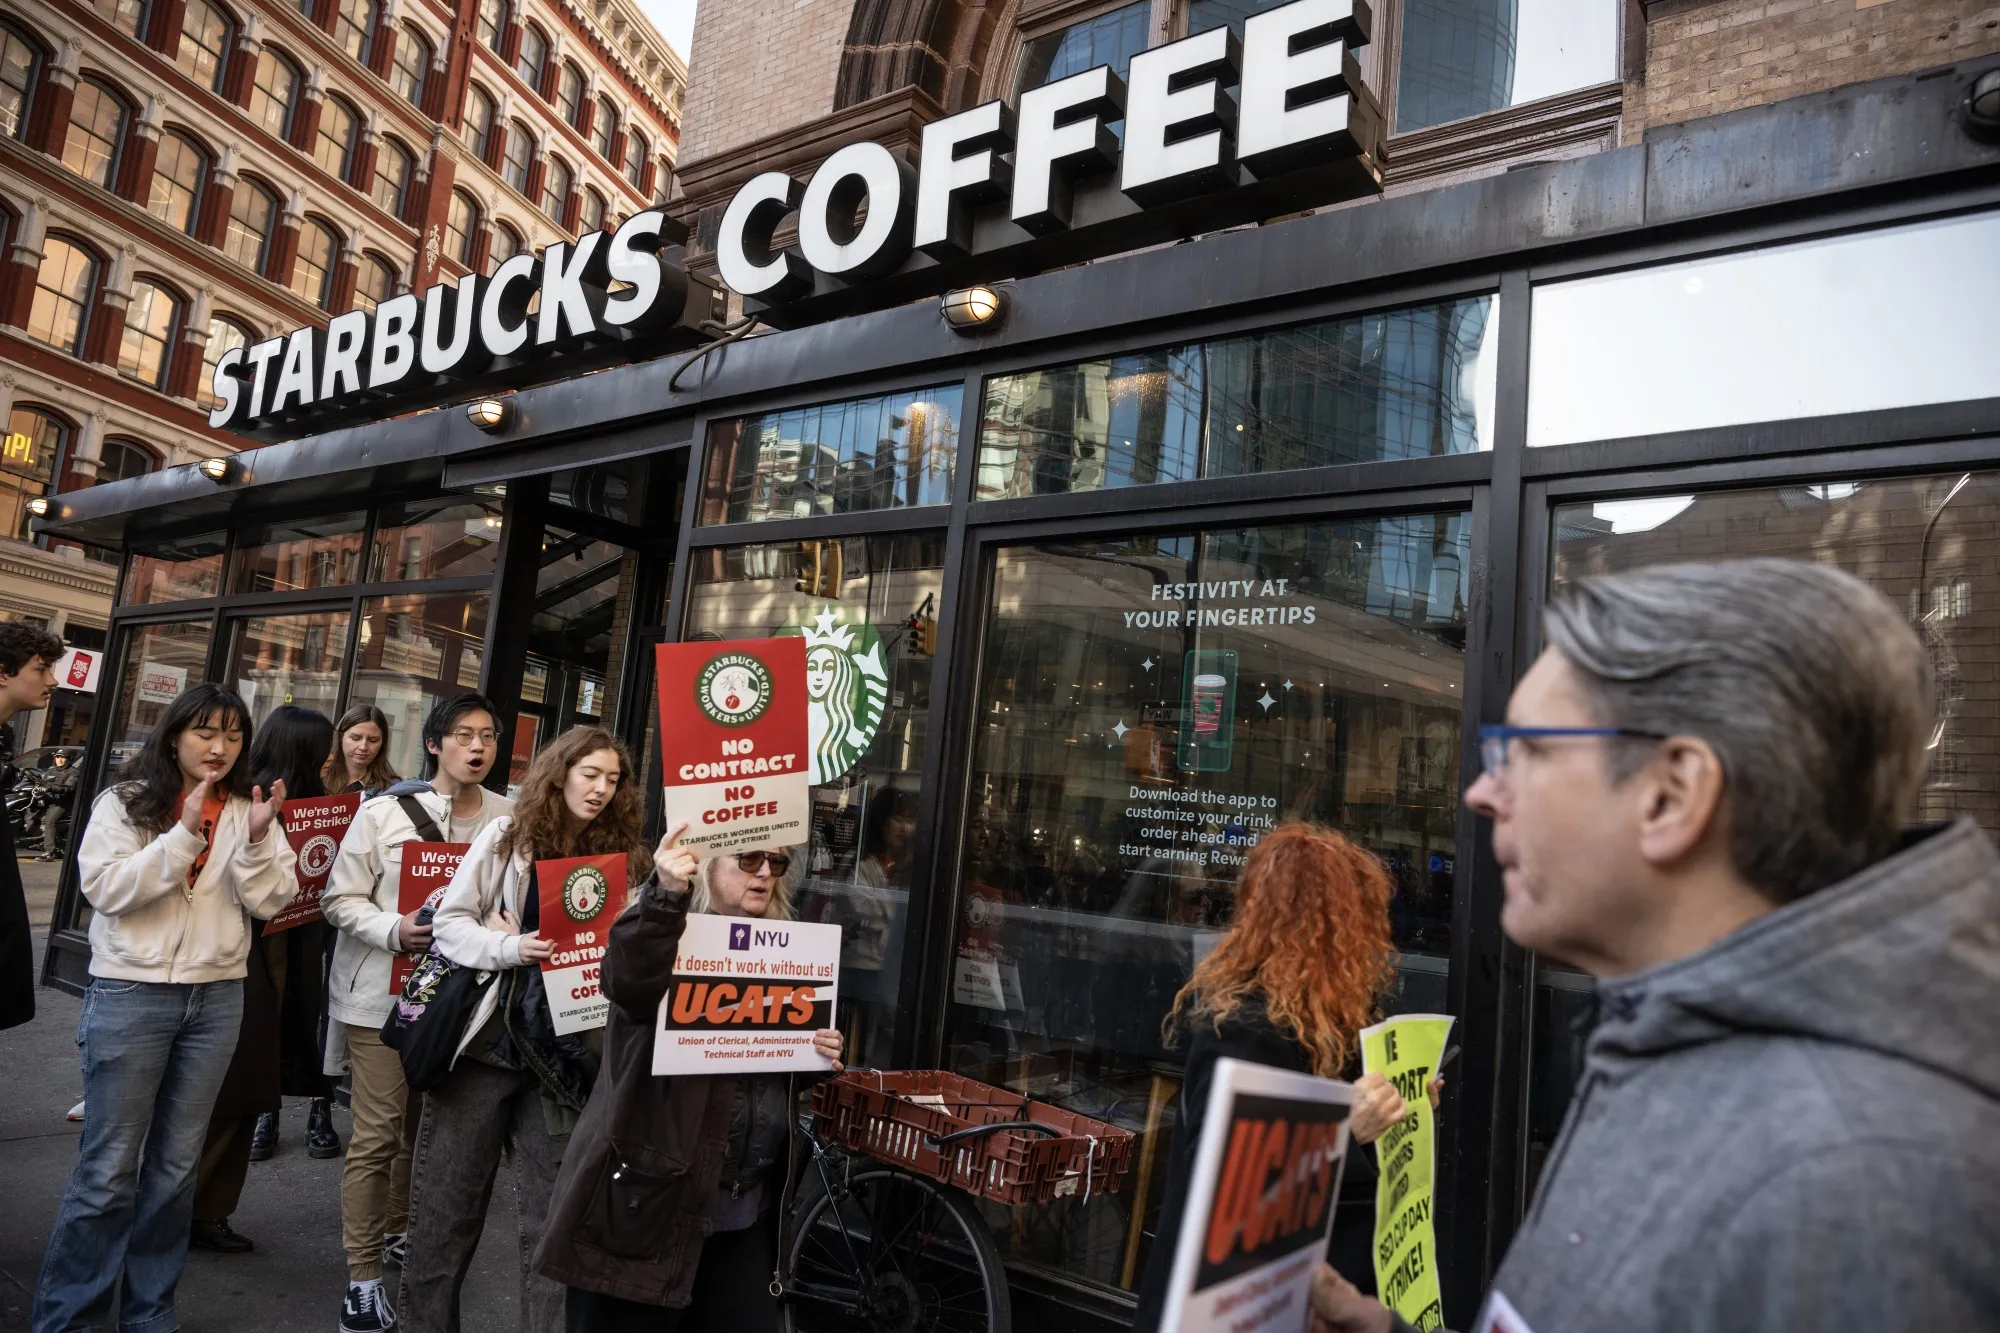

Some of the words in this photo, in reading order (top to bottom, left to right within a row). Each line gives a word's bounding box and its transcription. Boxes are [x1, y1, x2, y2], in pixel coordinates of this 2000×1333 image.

[208, 211, 665, 429] STARBUCKS
[716, 0, 1355, 298] COFFEE
[1151, 580, 1254, 601] FESTIVITY
[1260, 578, 1289, 597] AT
[1124, 611, 1178, 628] YOUR
[1185, 606, 1316, 627] FINGERTIPS
[704, 656, 765, 679] STARBUCKS
[700, 685, 738, 724] WORKERS
[745, 682, 770, 720] UNITED
[721, 738, 754, 756] NO
[679, 754, 796, 781] CONTRACT
[724, 785, 755, 802] NO
[1129, 786, 1198, 803] Download
[1202, 789, 1225, 804] the
[1228, 794, 1257, 809] app
[1261, 795, 1277, 808] to
[293, 806, 329, 819] We're
[332, 804, 347, 814] on
[702, 801, 778, 825] COFFEE
[1125, 806, 1195, 822] customize
[1198, 812, 1230, 826] your
[1233, 812, 1277, 831] drink,
[286, 820, 311, 833] ULP
[314, 815, 352, 829] Strike!
[679, 832, 729, 847] STARBUCKS
[730, 825, 770, 840] WORKERS
[771, 820, 800, 833] UNITED
[304, 838, 334, 852] STARBUCKS
[709, 841, 722, 850] ON
[724, 838, 740, 848] ULP
[741, 833, 771, 845] STRIKE!
[1140, 826, 1178, 840] order
[1181, 828, 1225, 844] ahead
[1229, 834, 1257, 847] and
[421, 851, 465, 865] We're
[1118, 843, 1151, 857] start
[1153, 848, 1208, 866] earning
[1211, 850, 1249, 867] Rewa
[411, 866, 441, 878] ULP
[567, 867, 604, 887] STARBUCKS
[565, 891, 586, 920] WORKERS
[590, 887, 606, 917] UNITED
[288, 912, 303, 920] Cup
[575, 931, 595, 946] NO
[754, 930, 790, 948] NYU
[550, 946, 606, 966] CONTRA
[686, 955, 732, 973] doesn't
[736, 958, 767, 974] work
[767, 960, 814, 977] without
[817, 963, 834, 977] us!
[582, 967, 601, 981] NO
[559, 1006, 592, 1018] STARBUCKS
[672, 982, 816, 1025] UCATS
[678, 1037, 705, 1045] Union
[707, 1036, 716, 1045] of
[718, 1036, 750, 1046] Clerical,
[752, 1036, 811, 1045] Administrative
[704, 1050, 744, 1059] Technical
[746, 1049, 765, 1058] Staff
[767, 1050, 775, 1058] at
[776, 1049, 794, 1058] NYU
[1408, 1195, 1430, 1232] DAY
[1385, 1241, 1424, 1310] STRIKE!
